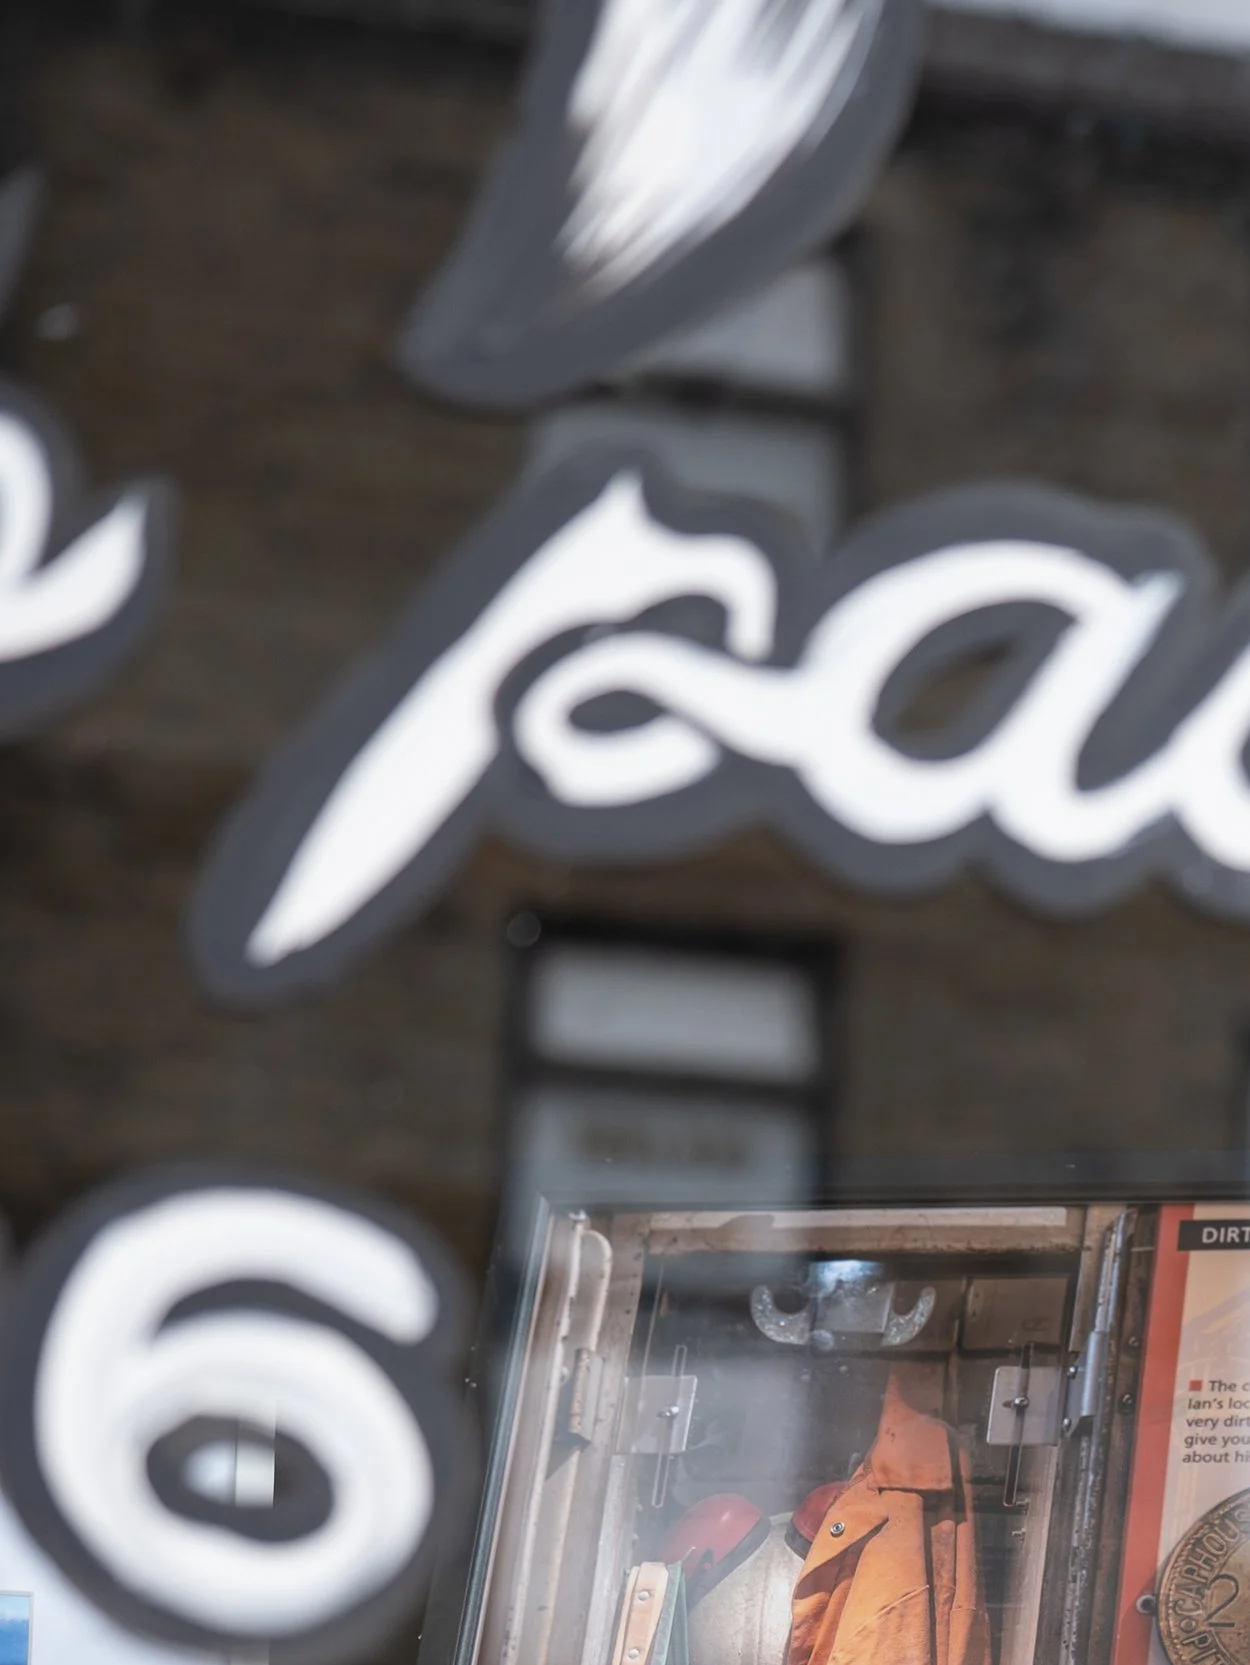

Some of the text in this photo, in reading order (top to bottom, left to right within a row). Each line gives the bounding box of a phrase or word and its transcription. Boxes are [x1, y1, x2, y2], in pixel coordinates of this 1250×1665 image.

[1209, 1380, 1237, 1392] The
[1187, 1397, 1224, 1410] Ian's
[33, 1185, 440, 1640] 6
[1186, 1418, 1220, 1430] very
[1184, 1433, 1217, 1448] give
[1221, 1435, 1250, 1448] you
[1182, 1450, 1230, 1464] about
